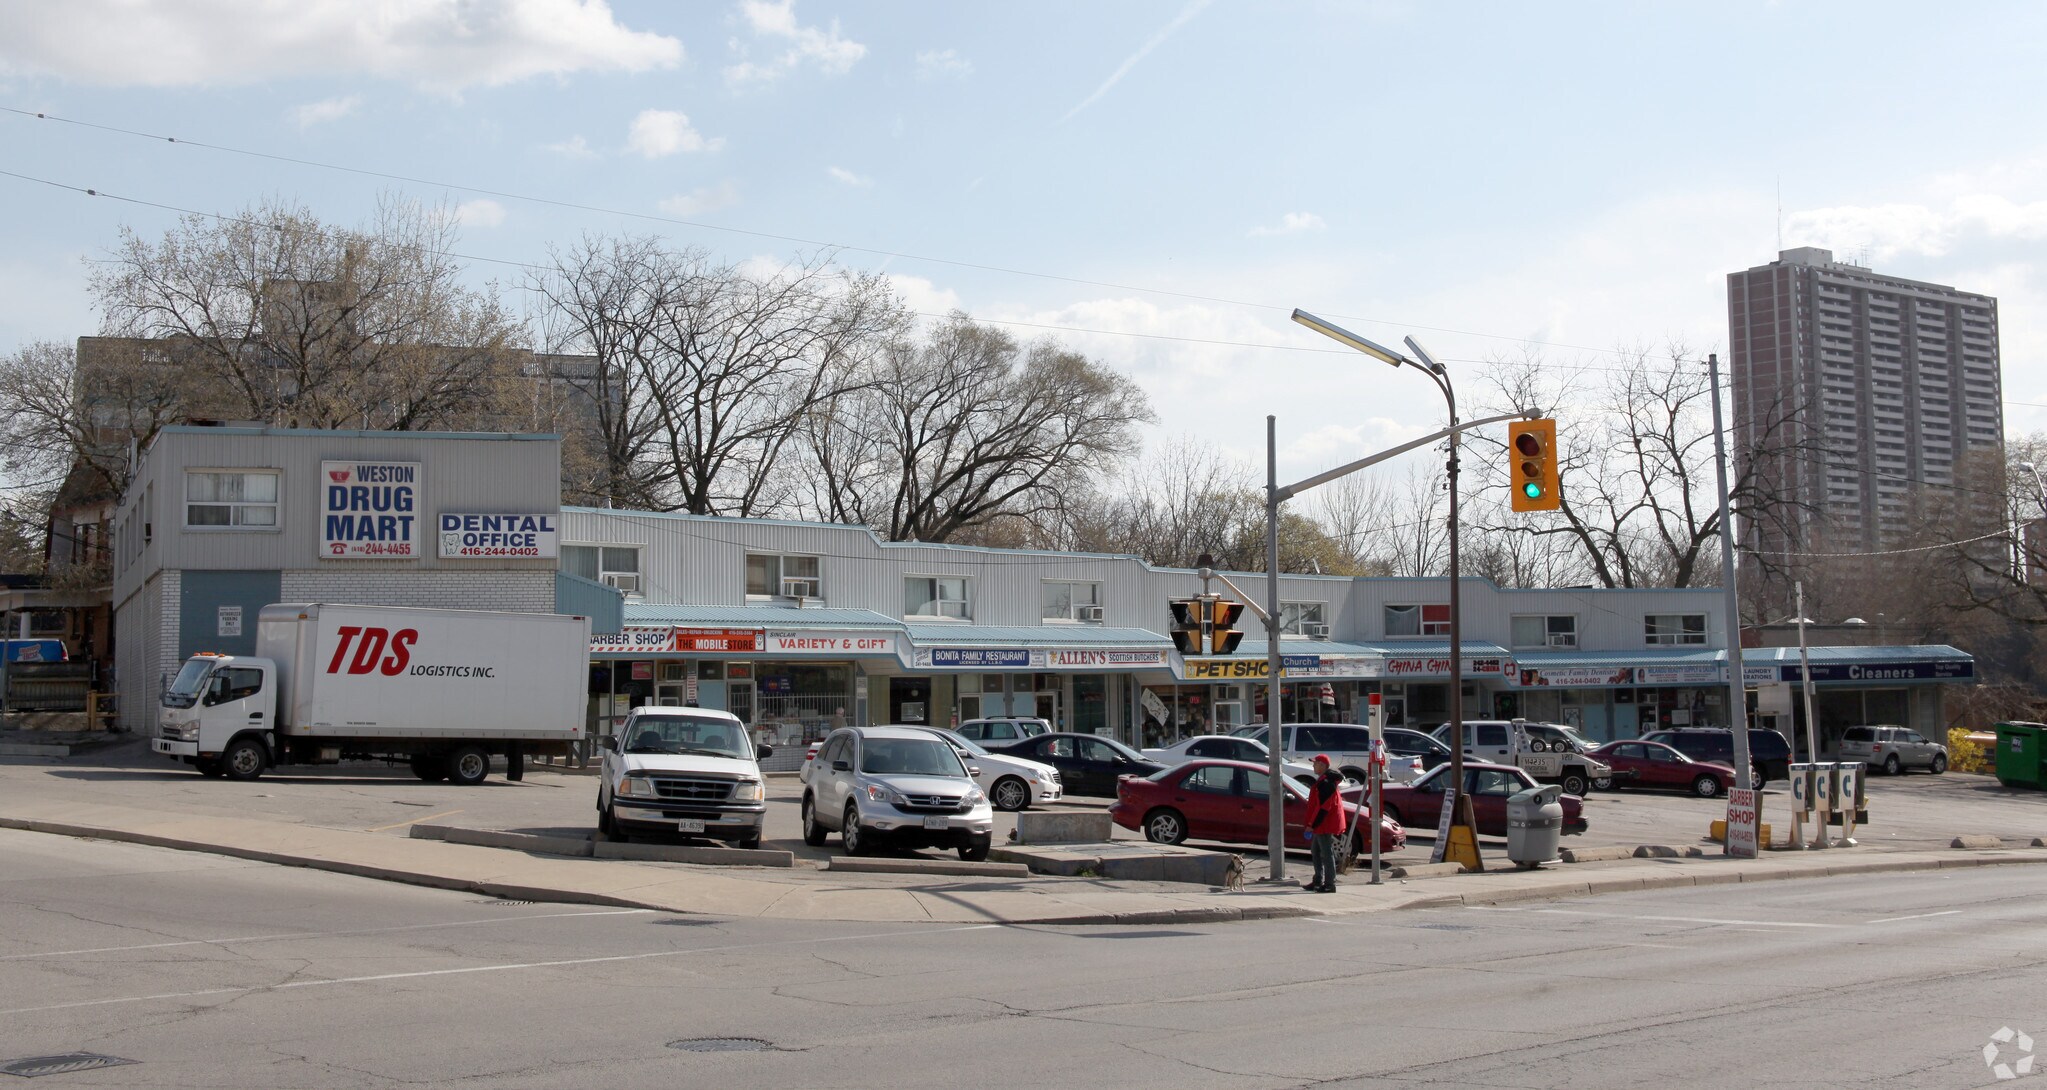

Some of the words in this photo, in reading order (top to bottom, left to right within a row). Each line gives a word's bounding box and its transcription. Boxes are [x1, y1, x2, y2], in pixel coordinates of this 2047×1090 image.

[357, 466, 414, 482] WESTON
[328, 486, 413, 512] DRUG
[326, 515, 414, 541] MART
[442, 515, 554, 532] DENTAL
[462, 533, 536, 546] OFFICE
[366, 542, 410, 555] 244-4455
[460, 548, 538, 556] 416-244-0402
[636, 634, 666, 645] SHOP
[678, 639, 693, 649] THE
[778, 638, 837, 649] VARIETY
[842, 639, 851, 649] &
[857, 639, 886, 649] GIFT
[326, 626, 418, 676] TDS
[935, 650, 959, 660] BONITA
[961, 650, 984, 661] FAMILY
[986, 651, 1026, 661] RESTAURANT
[1058, 650, 1106, 665] ALLEN'S
[1109, 653, 1133, 662] SCOTTISH
[1134, 653, 1159, 661] BUTCHERS
[1283, 657, 1312, 667] Church
[1388, 659, 1422, 675] CHINA
[1426, 659, 1452, 674] CHIN
[410, 665, 470, 677] LOGISTICS
[472, 667, 495, 678] INC.
[1196, 662, 1232, 677] PET
[1233, 662, 1283, 676] SHO
[1591, 668, 1617, 676] Dentistry
[1849, 665, 1915, 679] Cleaners
[1730, 790, 1753, 807] BARBER
[1729, 808, 1754, 825] SHOP
